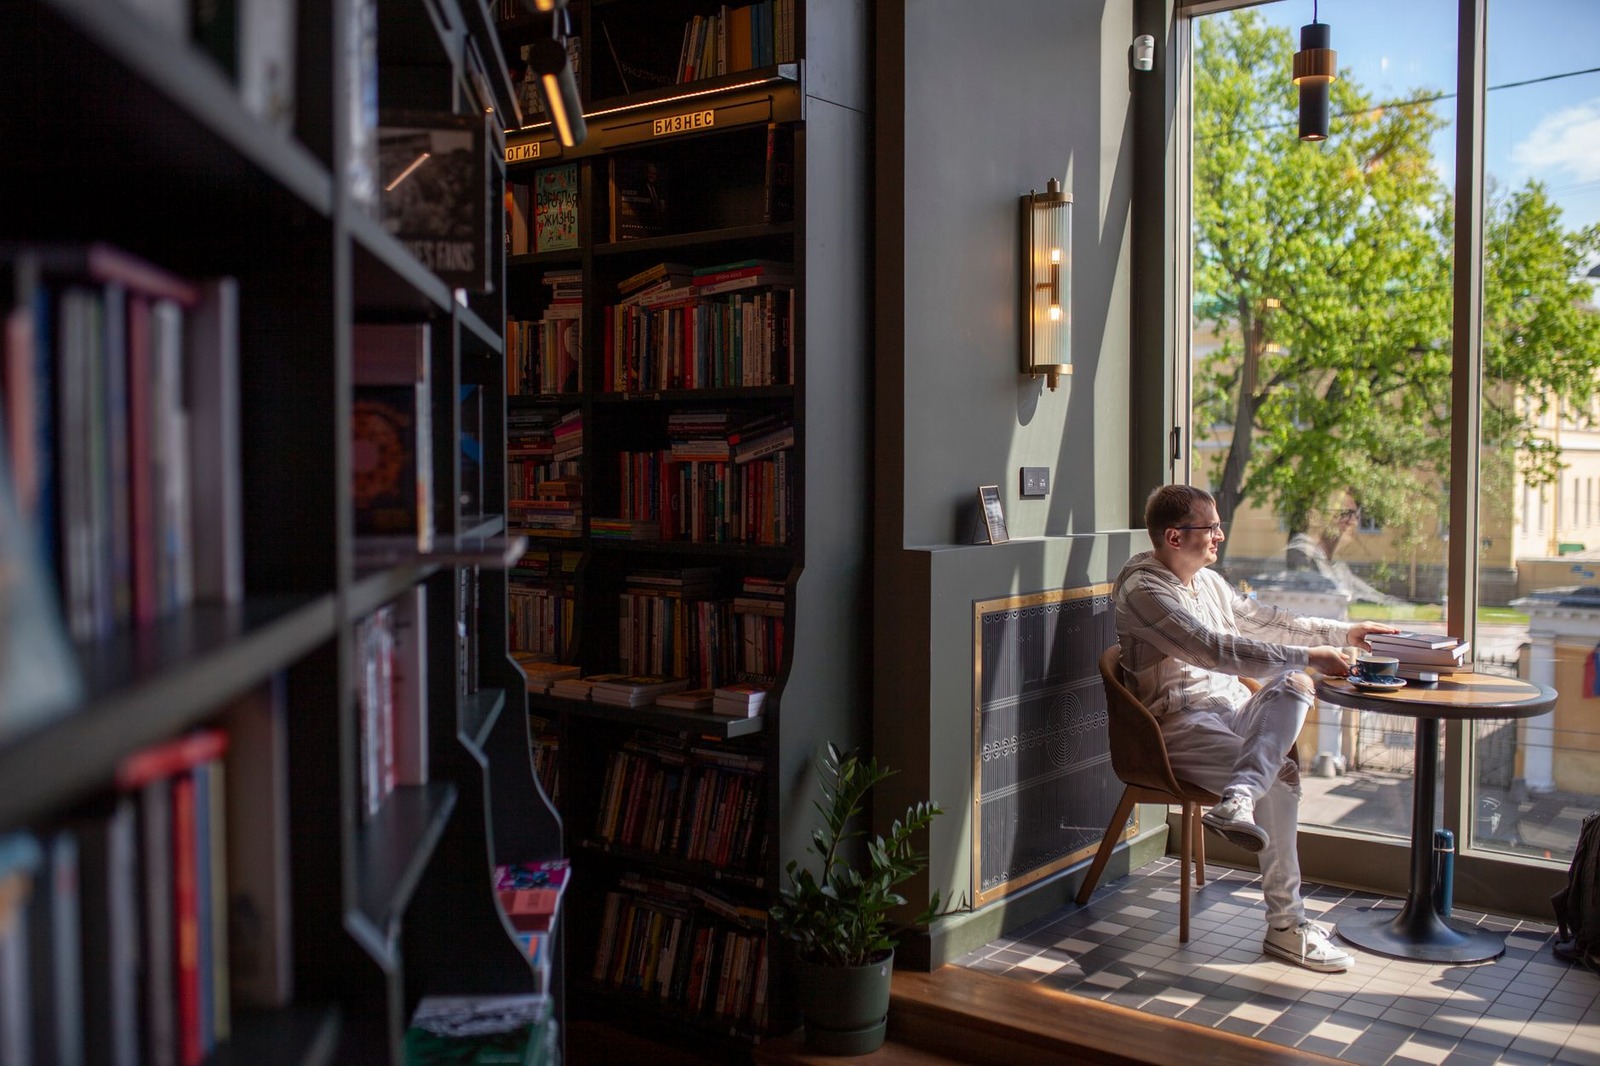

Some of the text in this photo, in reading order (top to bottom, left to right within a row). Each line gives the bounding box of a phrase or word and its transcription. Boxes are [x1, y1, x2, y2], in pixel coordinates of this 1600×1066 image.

[655, 111, 712, 134] БИЗНЕС
[504, 143, 539, 161] ОГИЯ
[544, 210, 576, 227] ЖИЗНЬ
[436, 240, 475, 272] FANS
